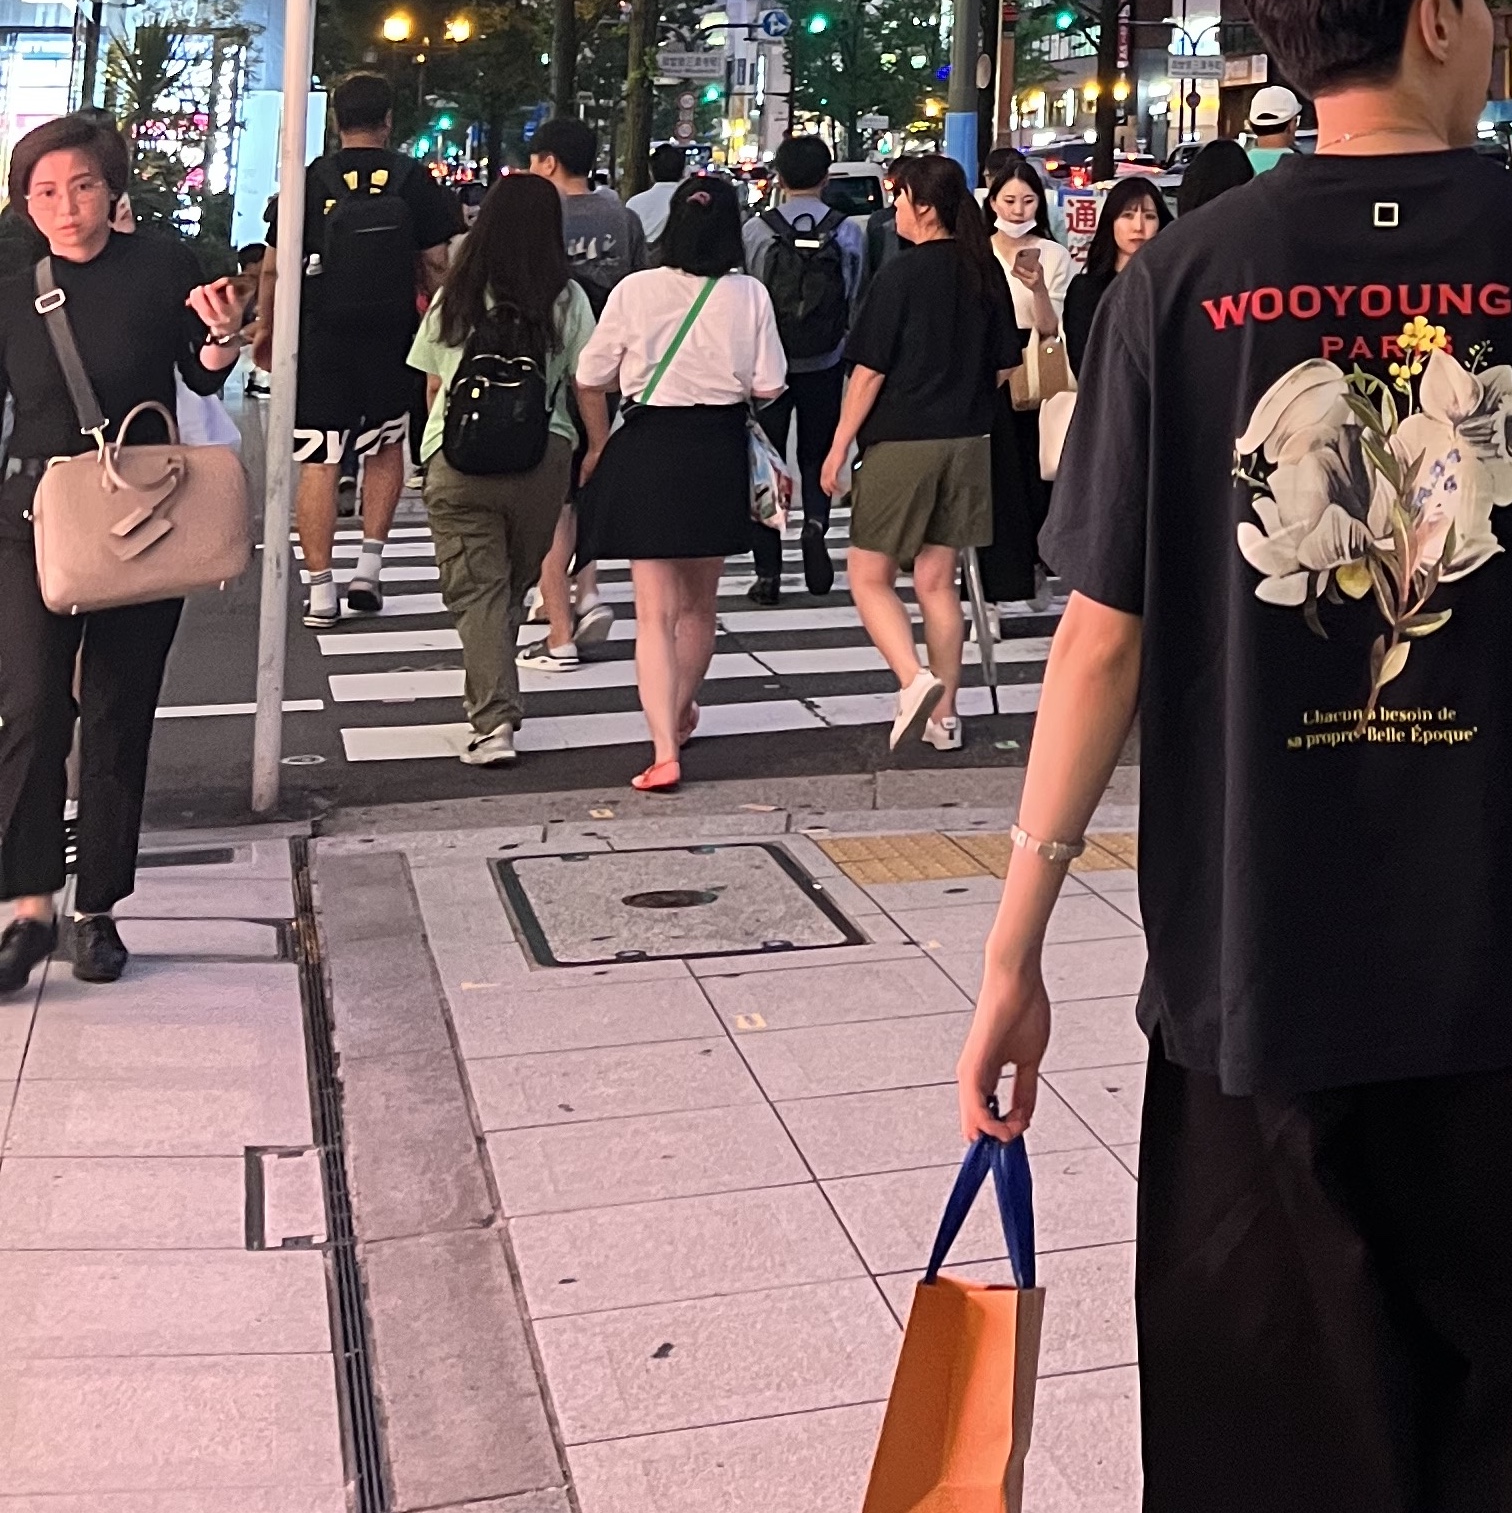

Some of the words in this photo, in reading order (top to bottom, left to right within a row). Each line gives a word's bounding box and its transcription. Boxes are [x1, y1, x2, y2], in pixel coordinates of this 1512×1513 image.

[1322, 335, 1454, 360] PAR
[1380, 706, 1433, 722] besoin
[1438, 706, 1457, 722] de
